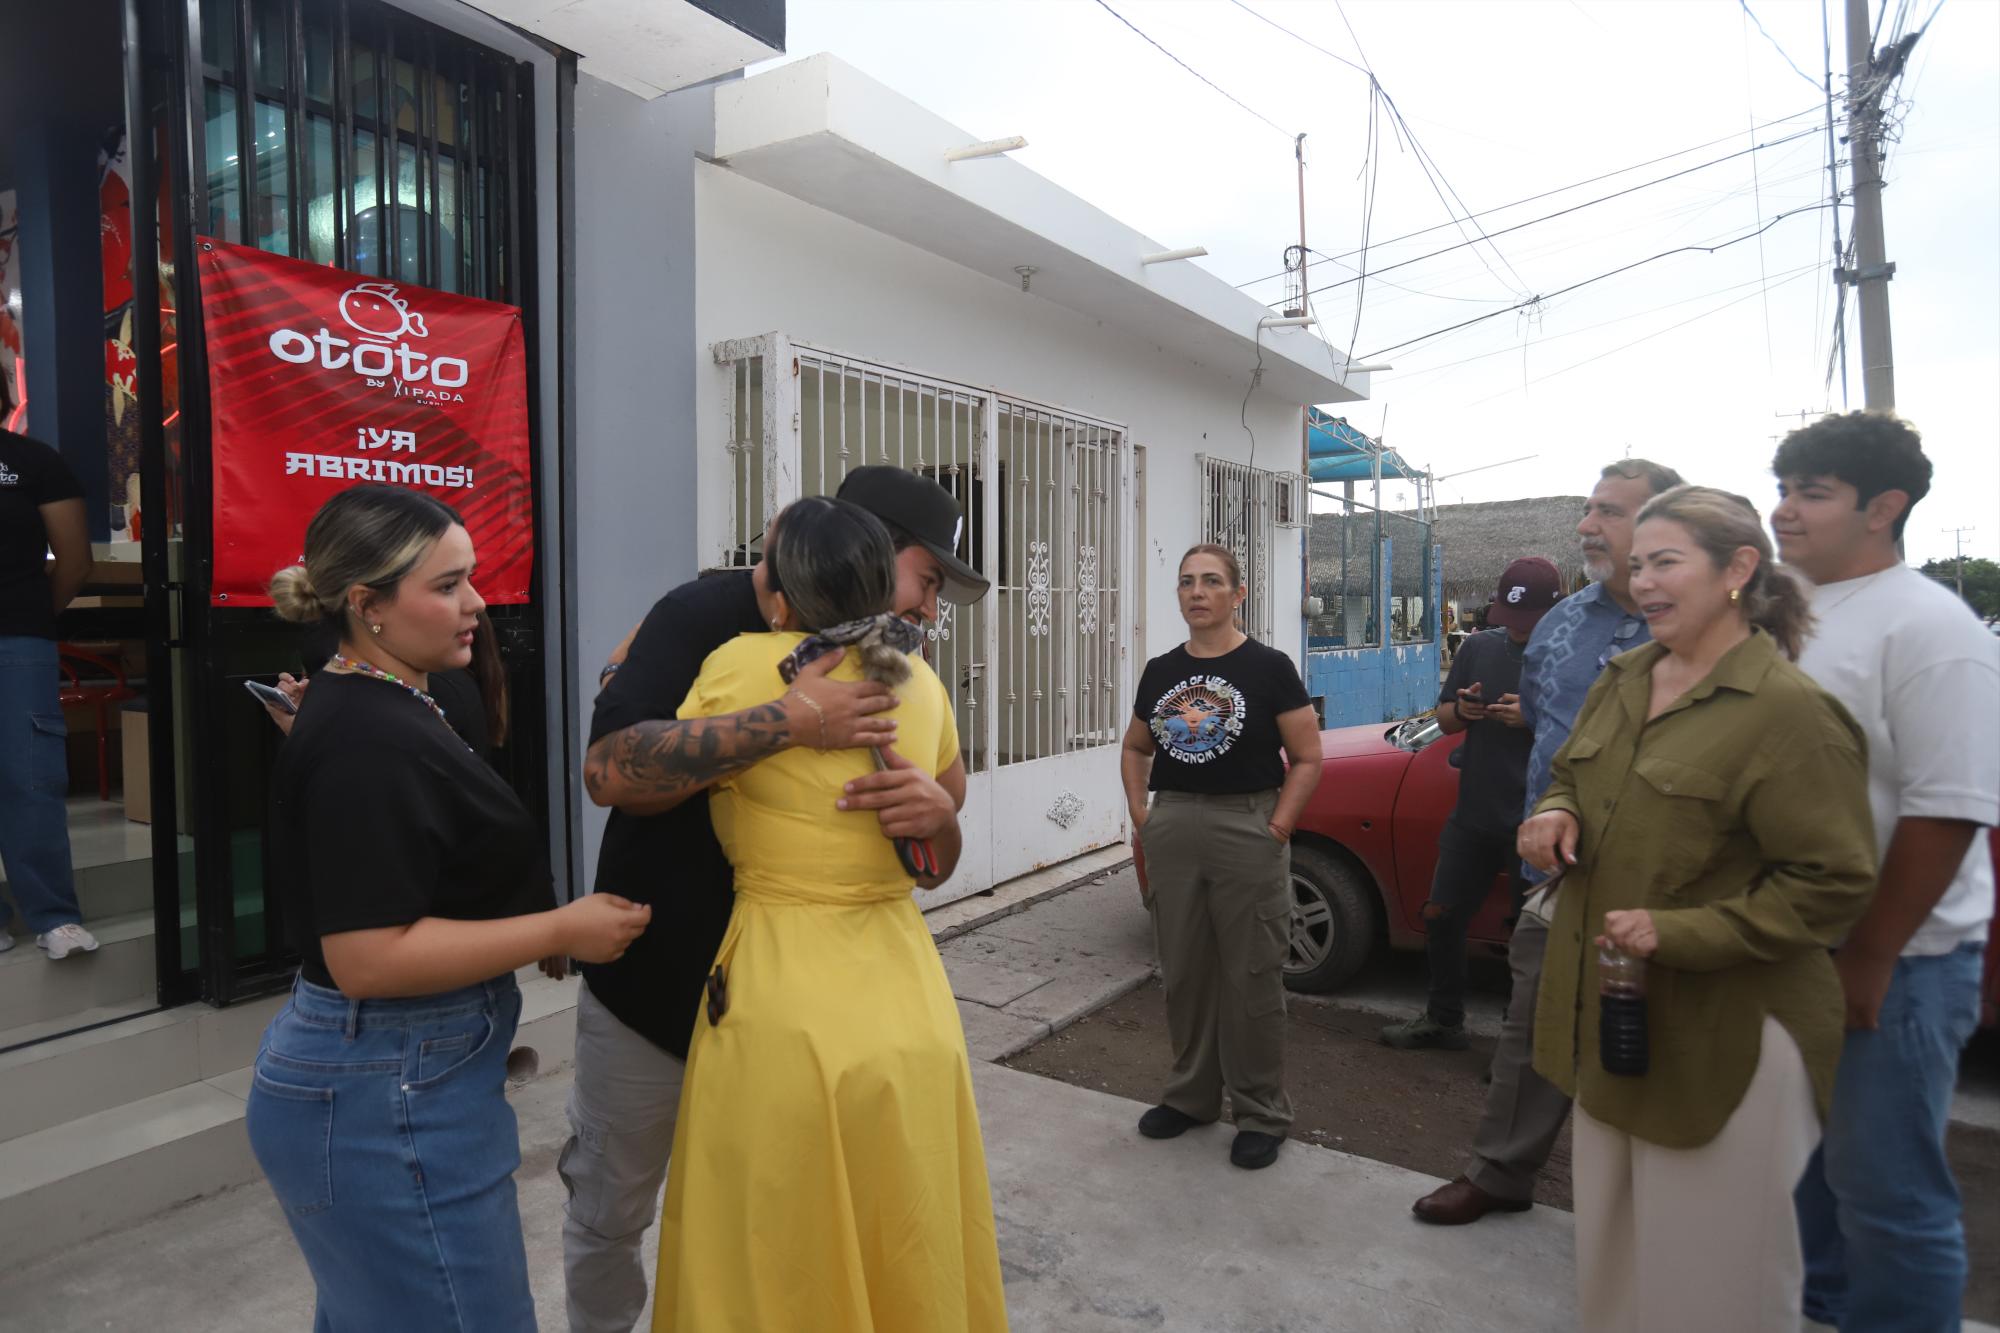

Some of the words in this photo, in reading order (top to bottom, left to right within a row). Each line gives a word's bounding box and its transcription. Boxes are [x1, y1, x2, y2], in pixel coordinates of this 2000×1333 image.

[357, 427, 416, 452] ¡YA
[285, 452, 475, 489] ABRIMOS!
[1189, 675, 1204, 685] OF
[1153, 680, 1188, 713] WONDER
[1169, 747, 1216, 763] WONDER
[1218, 736, 1236, 755] LIFE
